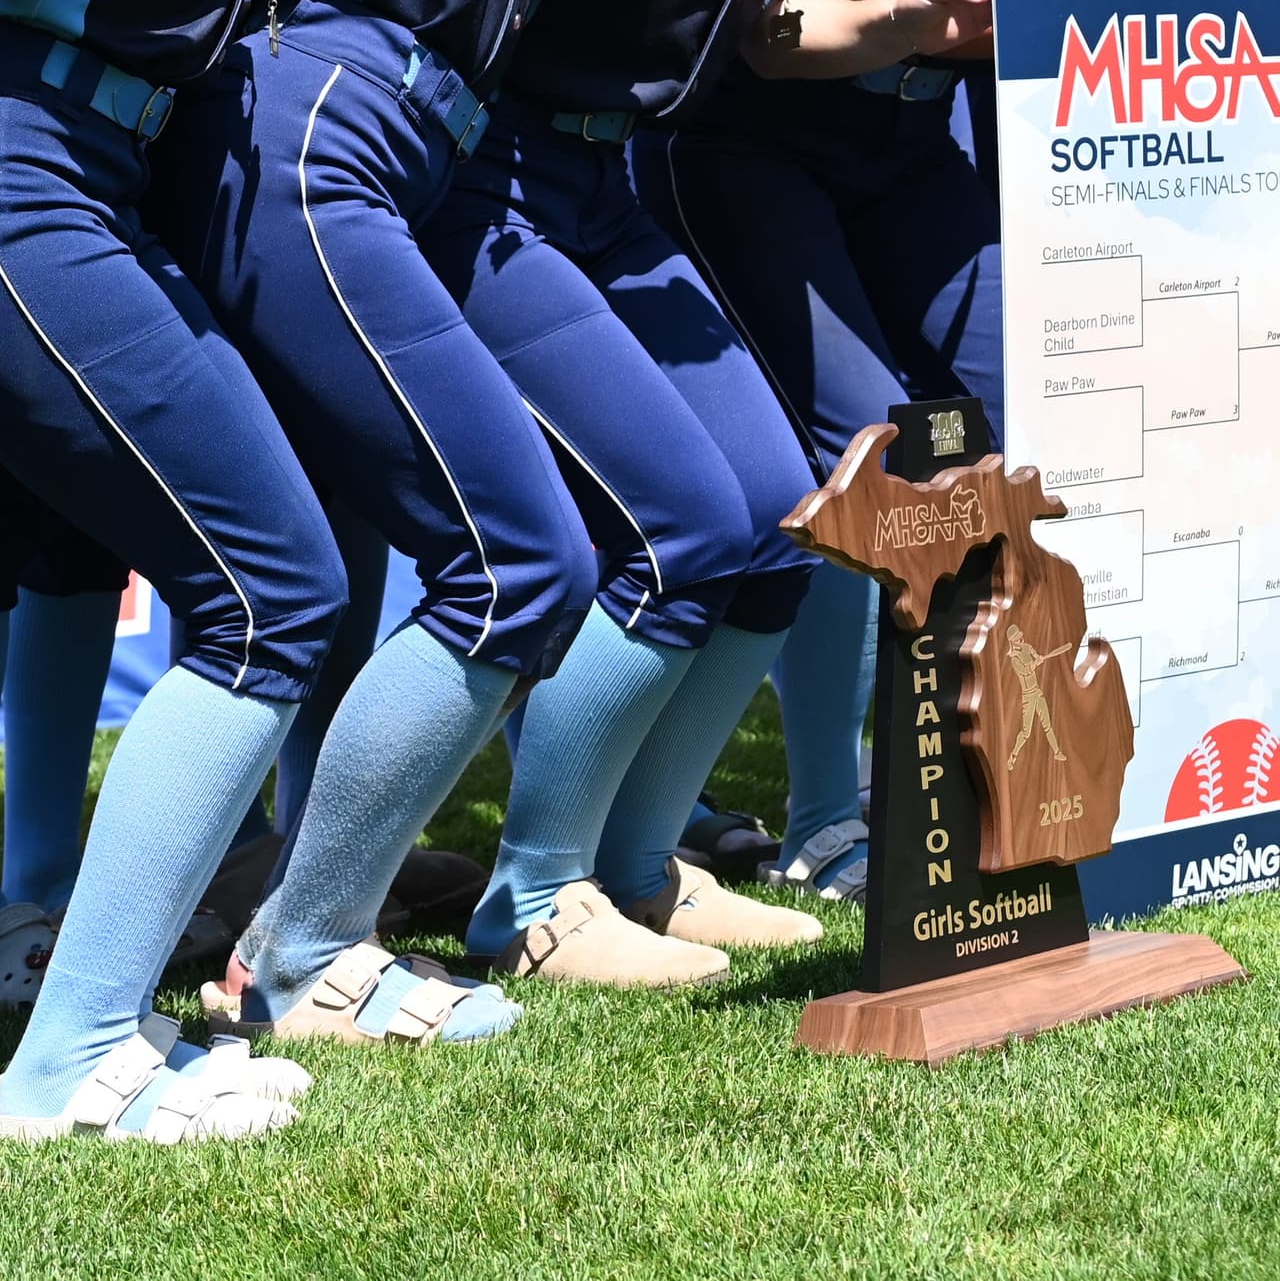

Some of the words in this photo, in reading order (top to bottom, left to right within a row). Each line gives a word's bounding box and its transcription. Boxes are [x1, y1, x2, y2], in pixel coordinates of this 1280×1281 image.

[1050, 129, 1225, 173] SOFTBALL
[1051, 178, 1170, 207] SEMI-FINALS
[1173, 177, 1186, 199] &
[1190, 173, 1252, 197] FINALS
[1042, 244, 1092, 261] Carleton
[1095, 241, 1134, 260] Airport
[1158, 281, 1193, 294] Carleton
[1193, 279, 1222, 292] Airport
[1233, 276, 1240, 287] 2
[1043, 317, 1098, 334] Dearborn
[1100, 312, 1135, 329] Divine
[1043, 336, 1075, 353] Child
[1044, 379, 1070, 393] Paw
[1071, 376, 1096, 391] Paw
[1171, 409, 1188, 420] Paw
[1188, 407, 1207, 418] Paw
[1045, 467, 1105, 486] Coldwater
[1067, 503, 1102, 518] anaba
[874, 498, 973, 552] MHSAA
[1172, 528, 1212, 544] Escanaba
[1238, 525, 1244, 536] 0
[1084, 587, 1129, 605] hristian
[1167, 651, 1209, 669] Richmond
[1239, 651, 1246, 662] 2
[910, 634, 953, 886] CHAMPION
[1039, 794, 1085, 827] 2025
[913, 904, 965, 942] Girls
[968, 881, 1053, 930] Softball
[955, 931, 1010, 958] DIVISION
[1011, 929, 1020, 945] 2
